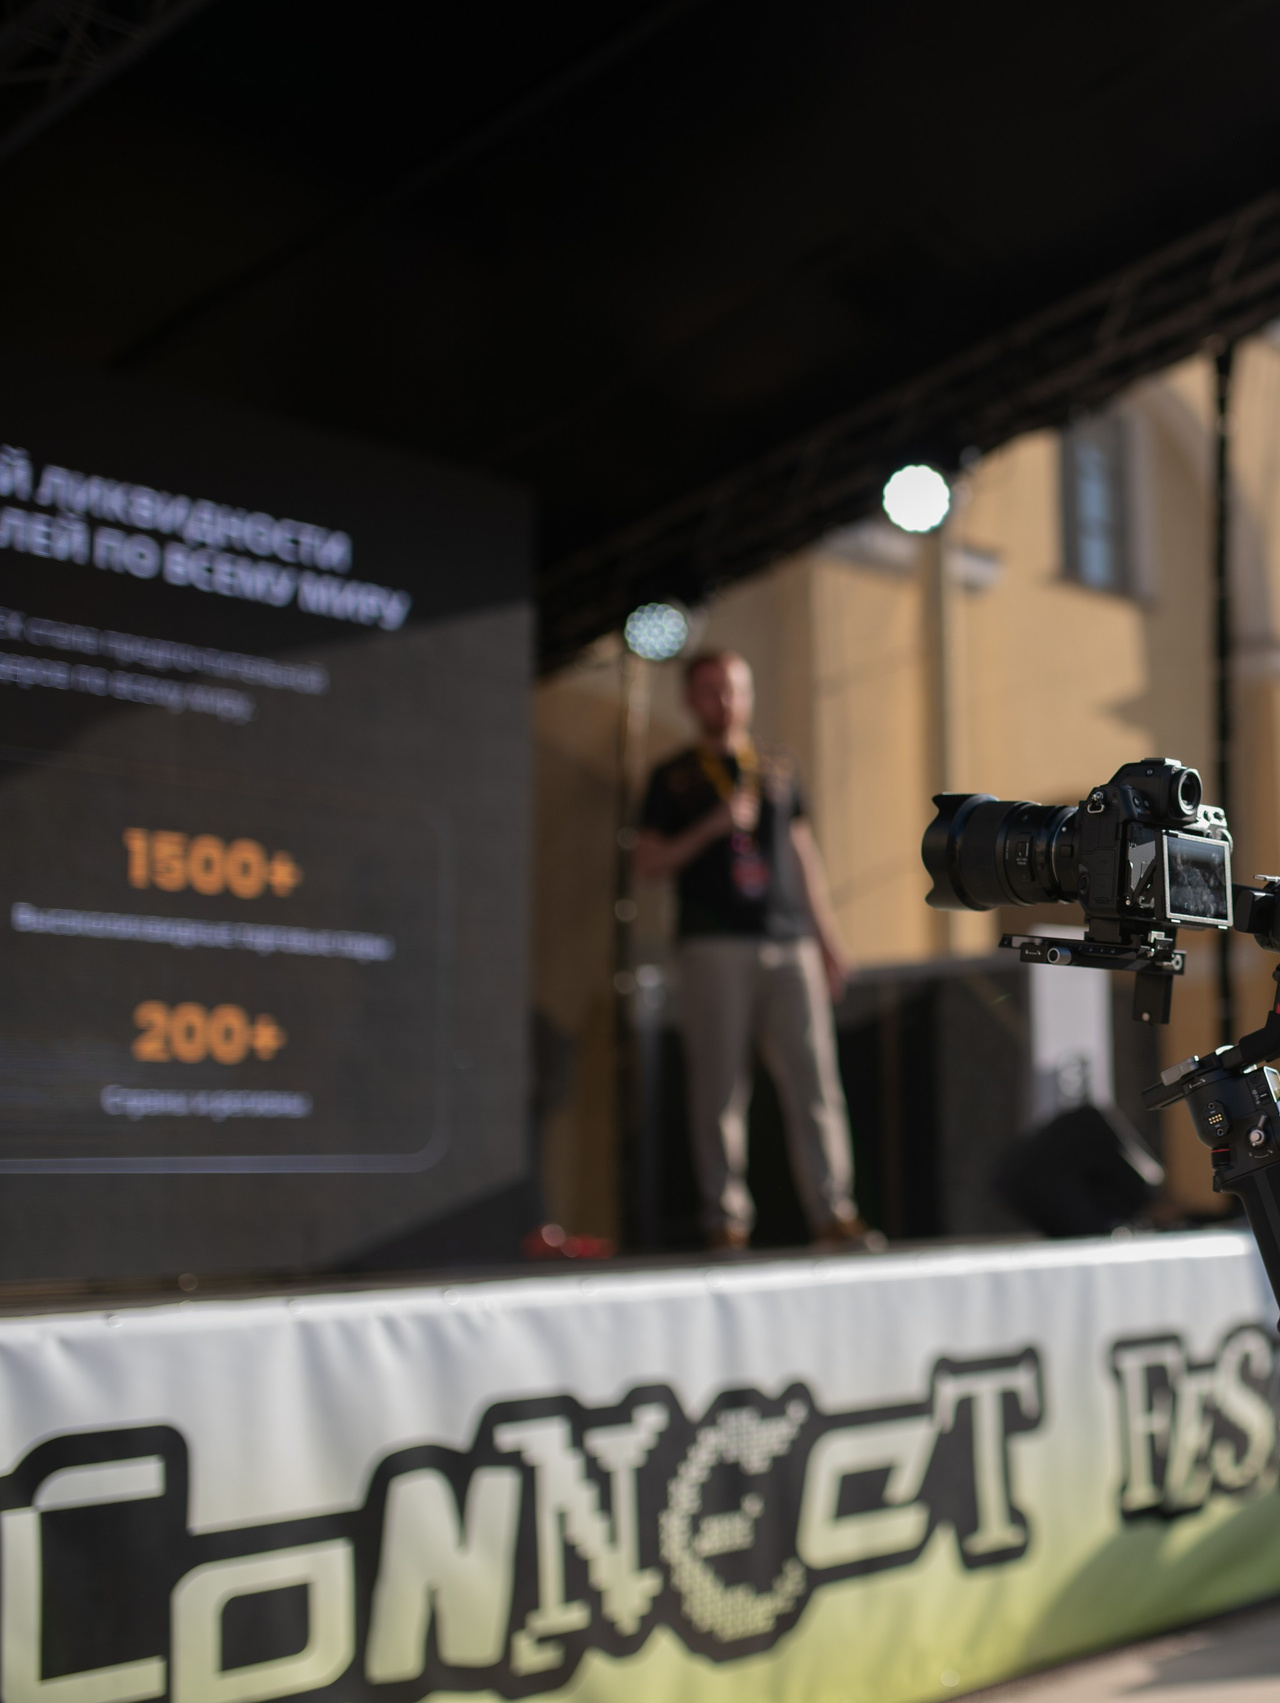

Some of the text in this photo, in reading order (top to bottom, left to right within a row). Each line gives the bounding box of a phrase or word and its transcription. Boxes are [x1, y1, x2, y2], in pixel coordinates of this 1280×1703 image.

[36, 464, 353, 575] ЛИКВИДНОСТИ
[93, 525, 162, 580] ПО
[163, 540, 299, 608] ВСЕМУ
[298, 570, 412, 632] МИРУ
[123, 827, 301, 899] 1500+
[132, 1000, 286, 1066] 200+
